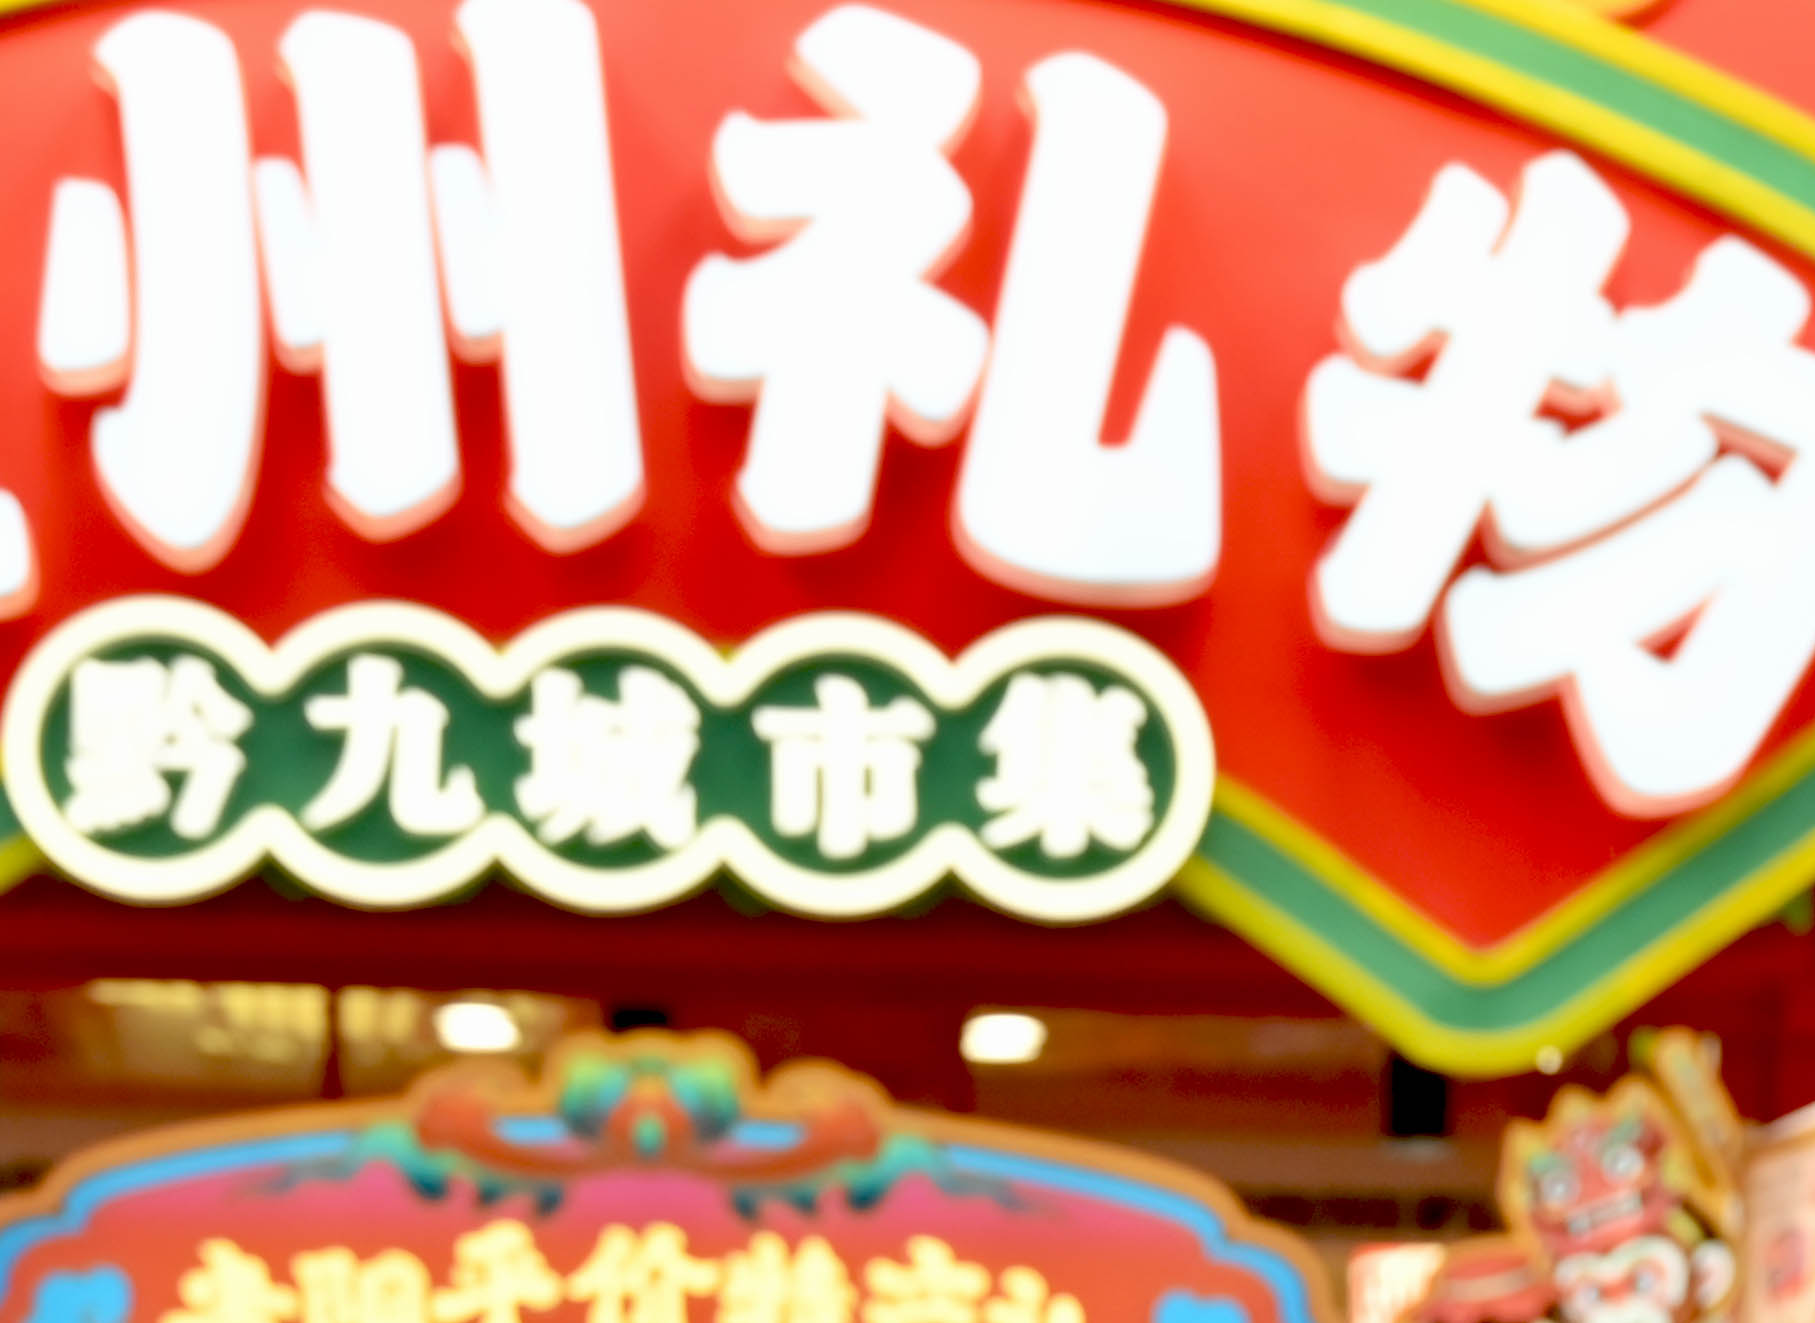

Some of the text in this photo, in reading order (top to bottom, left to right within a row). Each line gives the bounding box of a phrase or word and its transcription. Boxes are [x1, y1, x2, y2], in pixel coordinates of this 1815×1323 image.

[64, 655, 1156, 858] 黔九城市集
